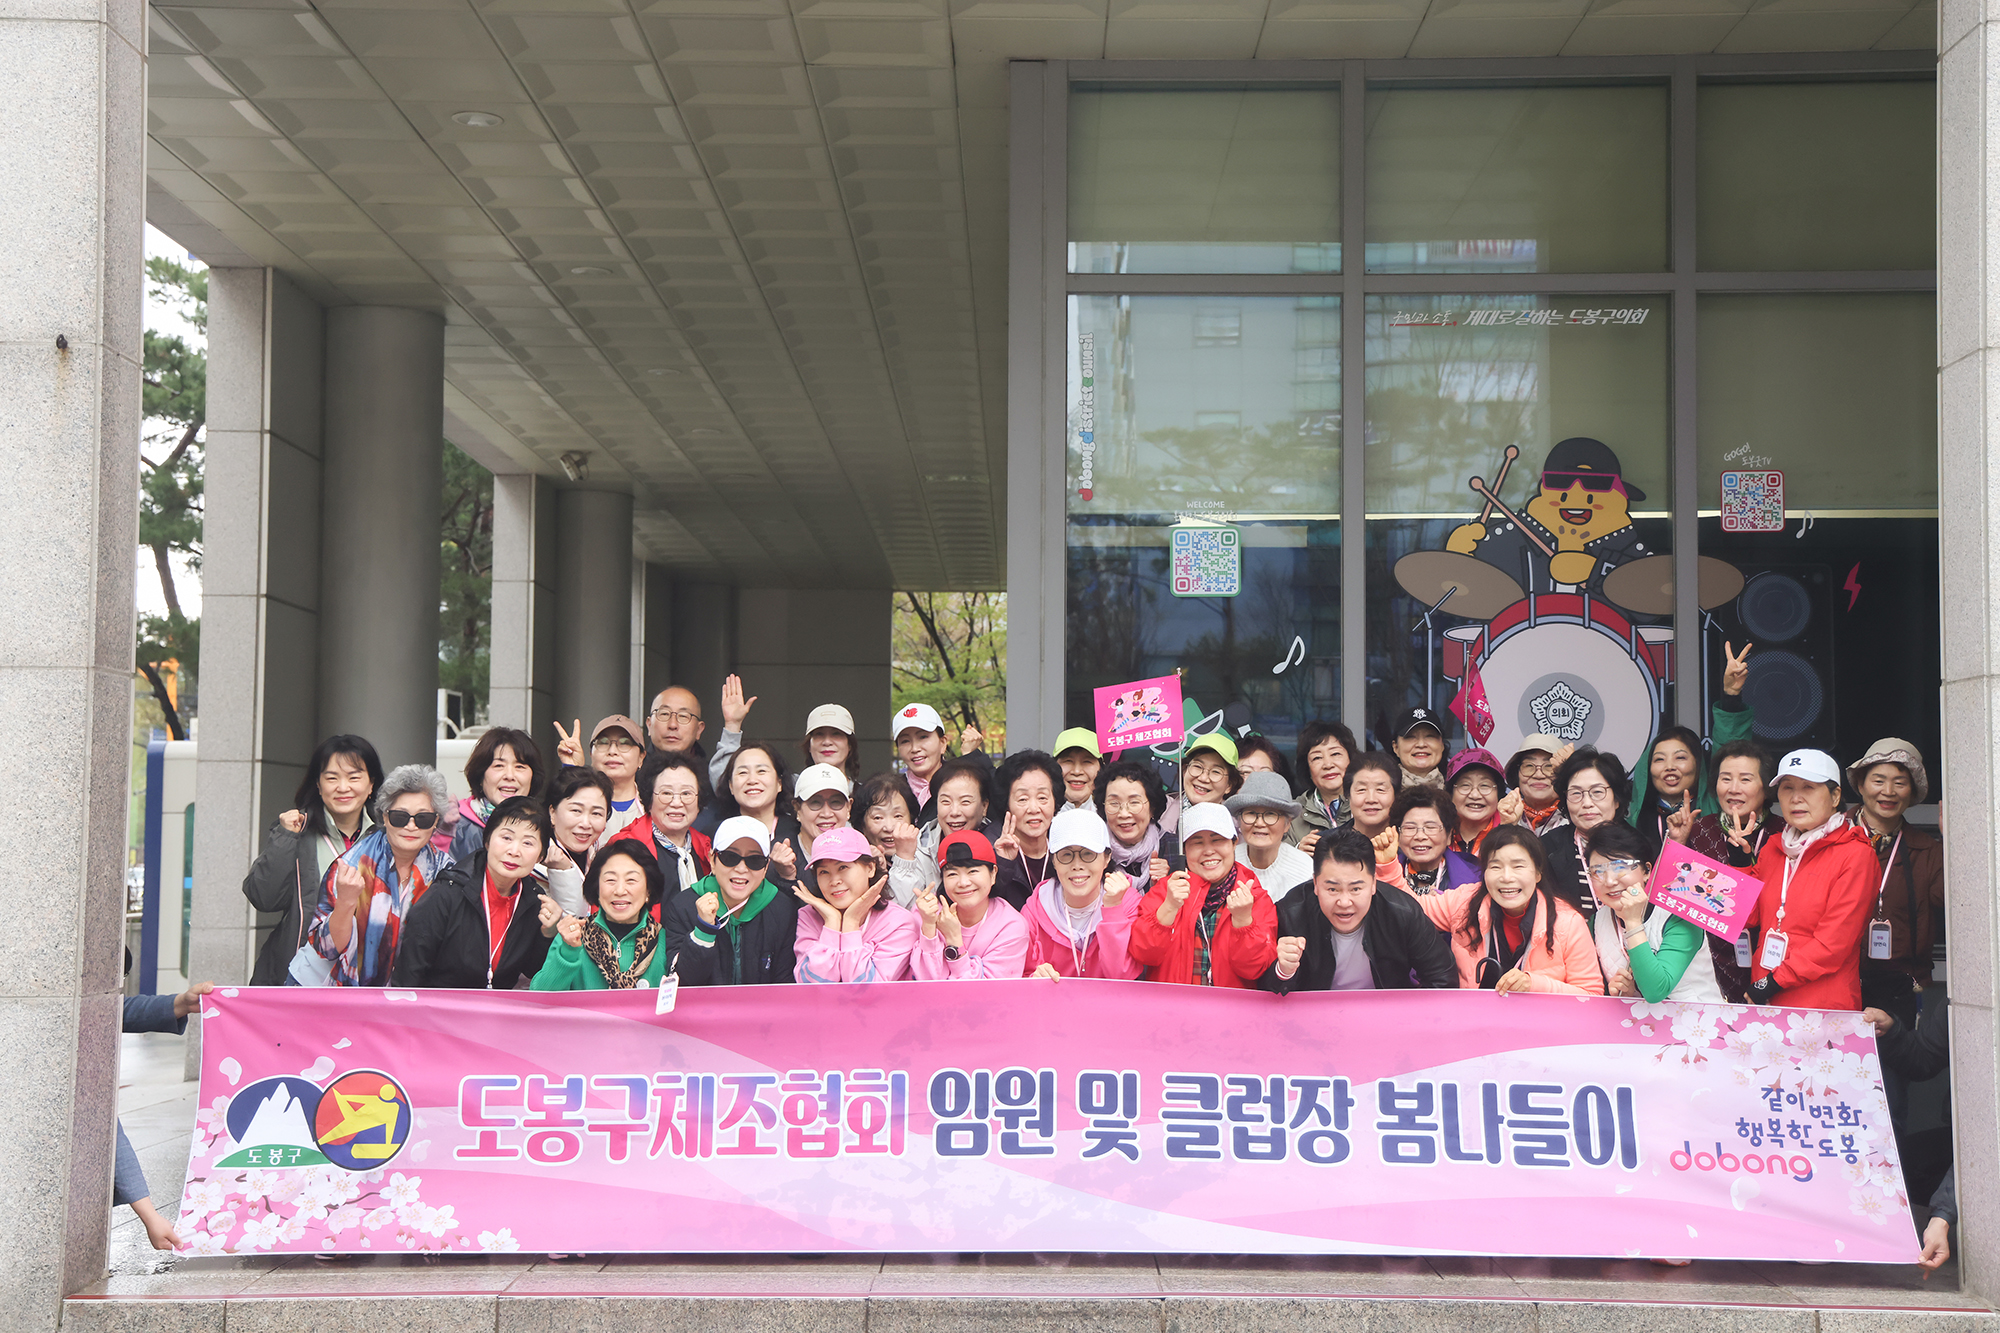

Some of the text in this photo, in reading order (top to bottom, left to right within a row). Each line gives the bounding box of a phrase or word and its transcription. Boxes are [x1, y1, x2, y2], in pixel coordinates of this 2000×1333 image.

[1565, 308, 1650, 326] 도봉구의회
[1723, 442, 1752, 461] GOGO!
[1552, 708, 1570, 718] 의회
[1107, 727, 1172, 747] 도봉구 체조협회
[1789, 757, 1802, 767] R
[1655, 892, 1729, 934] 도봉구 체조협회
[1760, 1087, 1805, 1113] 같이
[454, 1067, 1638, 1171] 도봉구체조협회 임원 및 클럽장 봄나들이
[1809, 1101, 1868, 1131] 변화,
[1735, 1117, 1814, 1148] 행복한
[247, 1148, 302, 1165] 도봉구
[1669, 1140, 1814, 1183] dobong
[1818, 1134, 1860, 1165] 도봉
